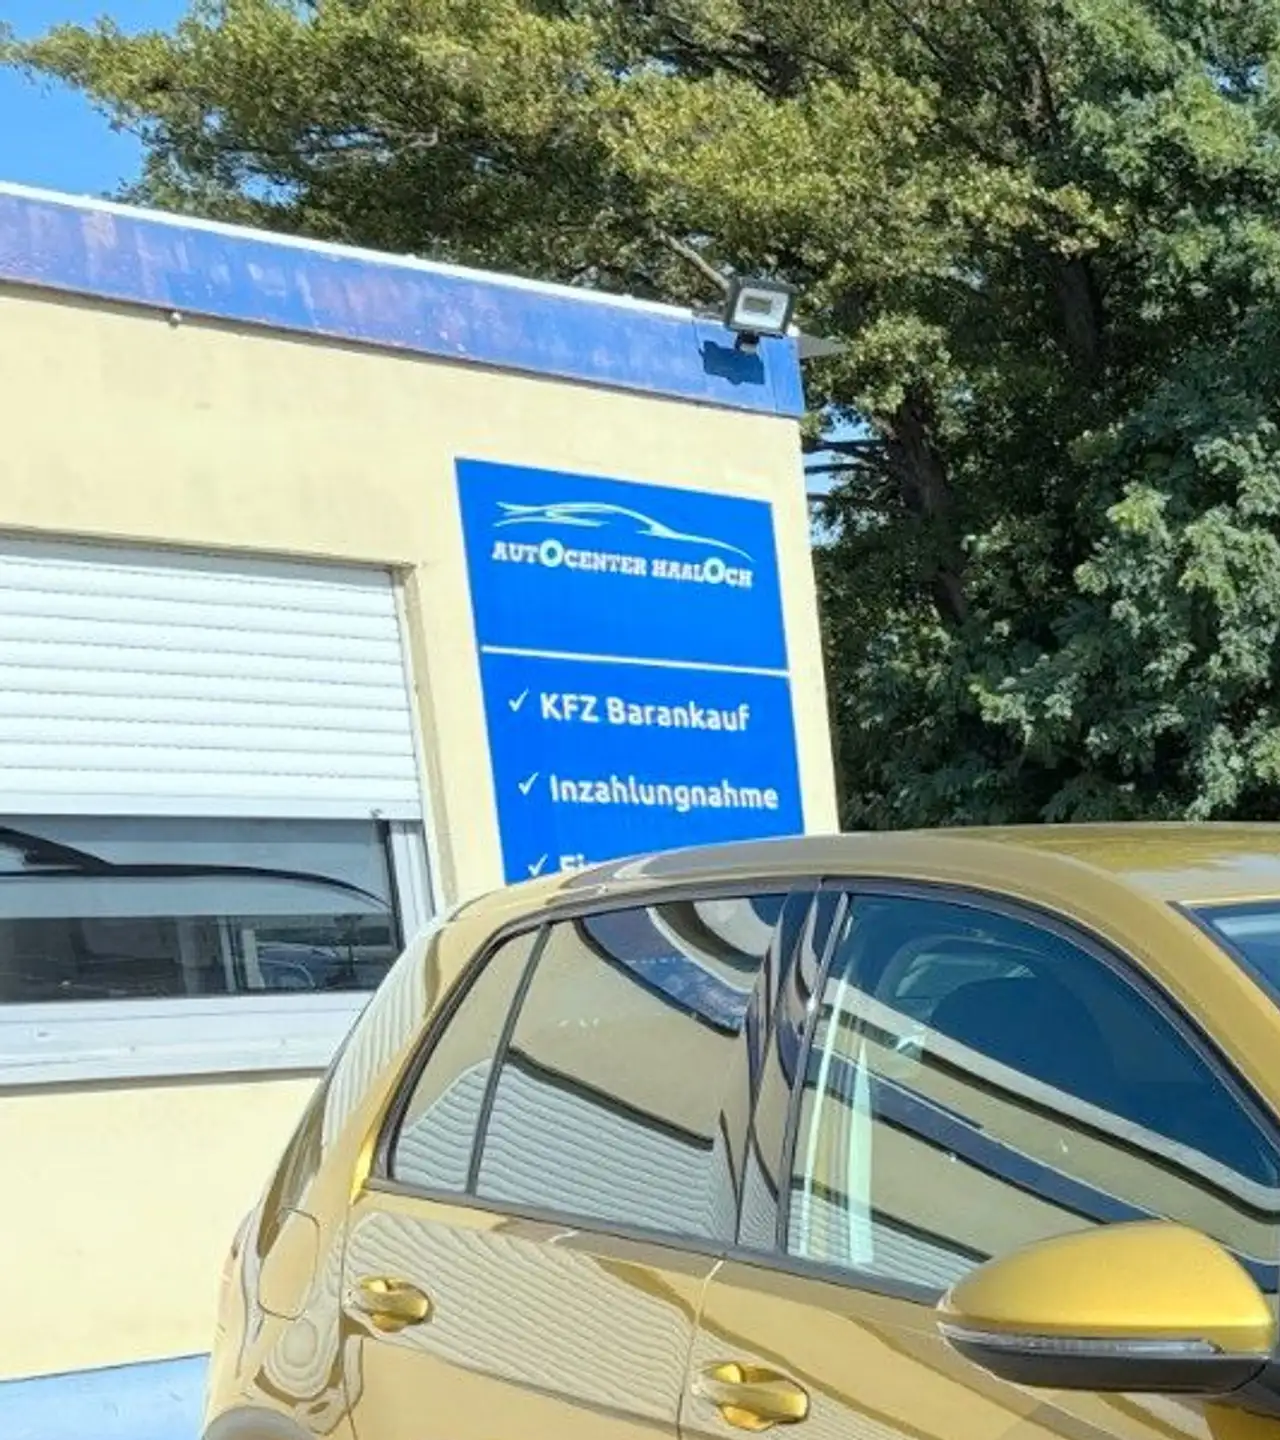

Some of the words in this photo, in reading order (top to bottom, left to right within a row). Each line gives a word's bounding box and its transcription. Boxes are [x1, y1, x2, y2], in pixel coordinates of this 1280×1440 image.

[492, 538, 647, 577] AUTOCENTER
[540, 692, 600, 723] KFZ
[606, 695, 750, 732] Barankauf
[550, 773, 780, 813] Inzahlungnahme
